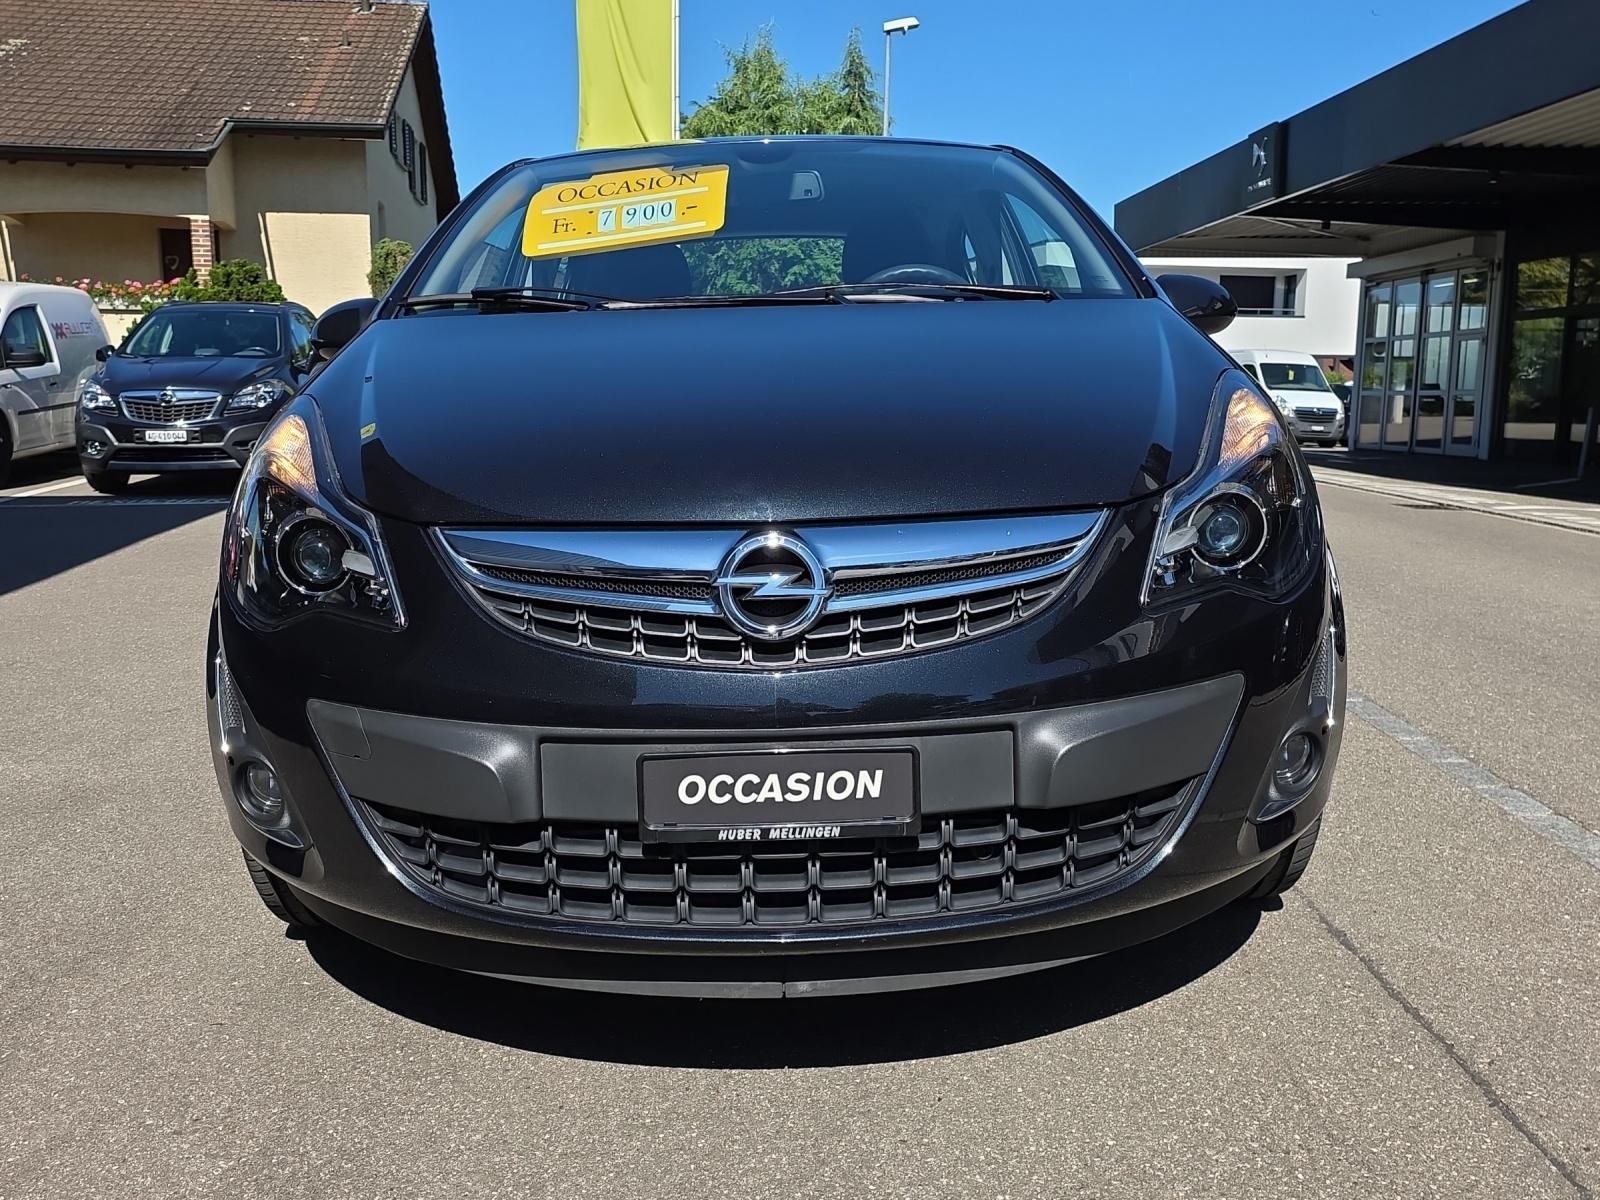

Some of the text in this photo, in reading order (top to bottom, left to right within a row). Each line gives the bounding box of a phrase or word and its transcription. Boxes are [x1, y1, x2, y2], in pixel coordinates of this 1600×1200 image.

[557, 171, 699, 203] OCCASION
[552, 218, 577, 234] Fr.
[677, 769, 884, 805] OCCASION
[718, 826, 841, 841] HUBER MELLINGEN
